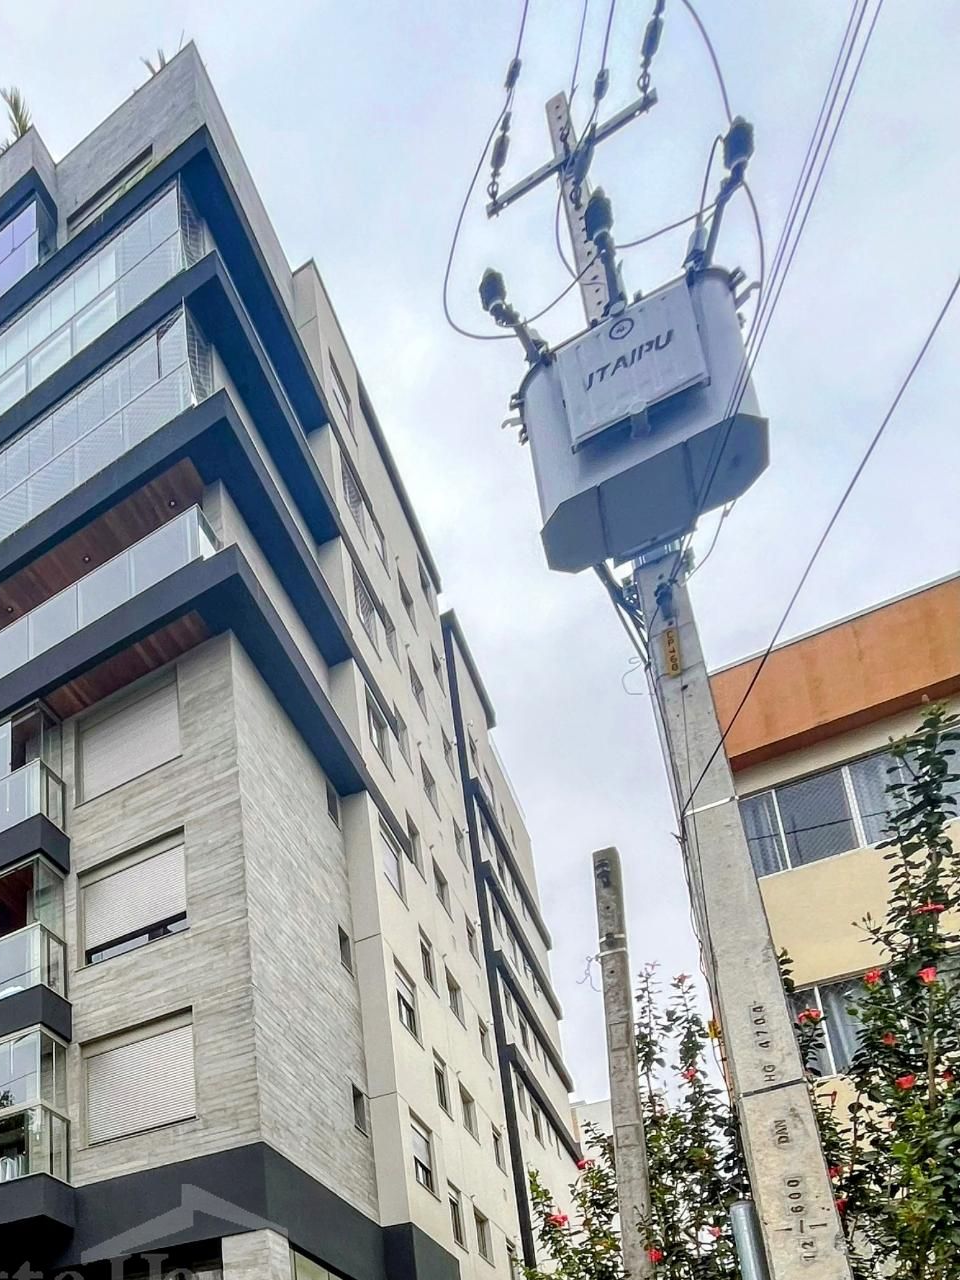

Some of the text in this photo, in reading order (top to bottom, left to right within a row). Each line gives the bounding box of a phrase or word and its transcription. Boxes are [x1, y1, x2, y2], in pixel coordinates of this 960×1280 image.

[586, 329, 674, 391] ITAIPU
[762, 1064, 776, 1081] HG
[774, 1119, 791, 1145] DAN
